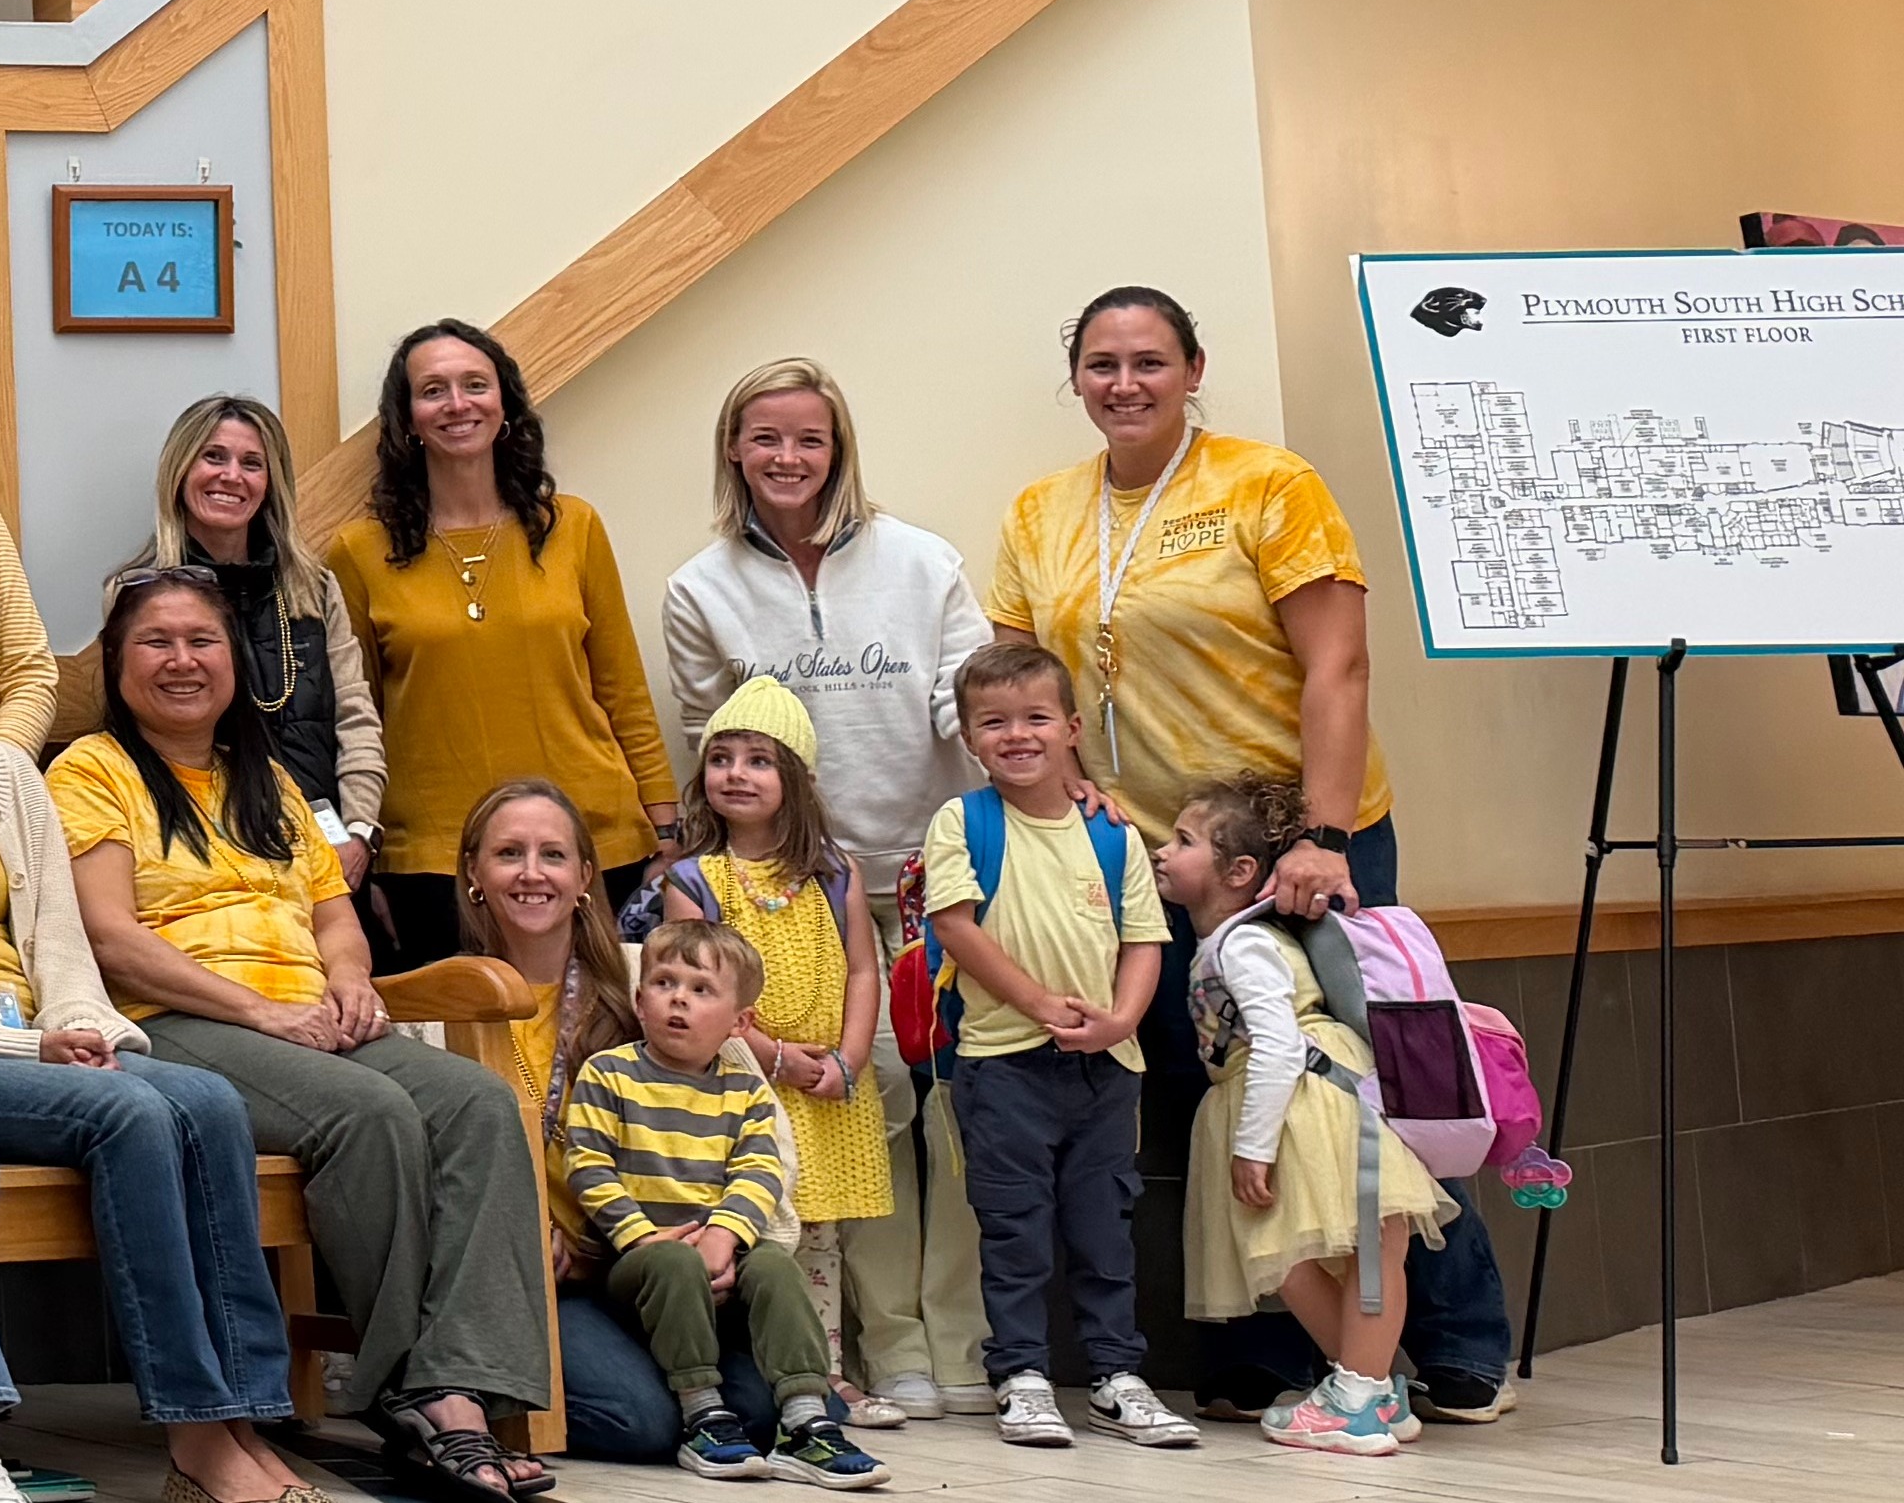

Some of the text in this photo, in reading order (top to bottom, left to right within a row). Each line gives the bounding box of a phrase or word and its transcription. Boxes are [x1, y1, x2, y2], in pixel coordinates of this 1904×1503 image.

[102, 222, 193, 238] TODAY IS:
[117, 261, 181, 293] A 4
[1682, 326, 1813, 344] FIRST FLOOR
[795, 647, 855, 678] States
[860, 642, 912, 681] Open
